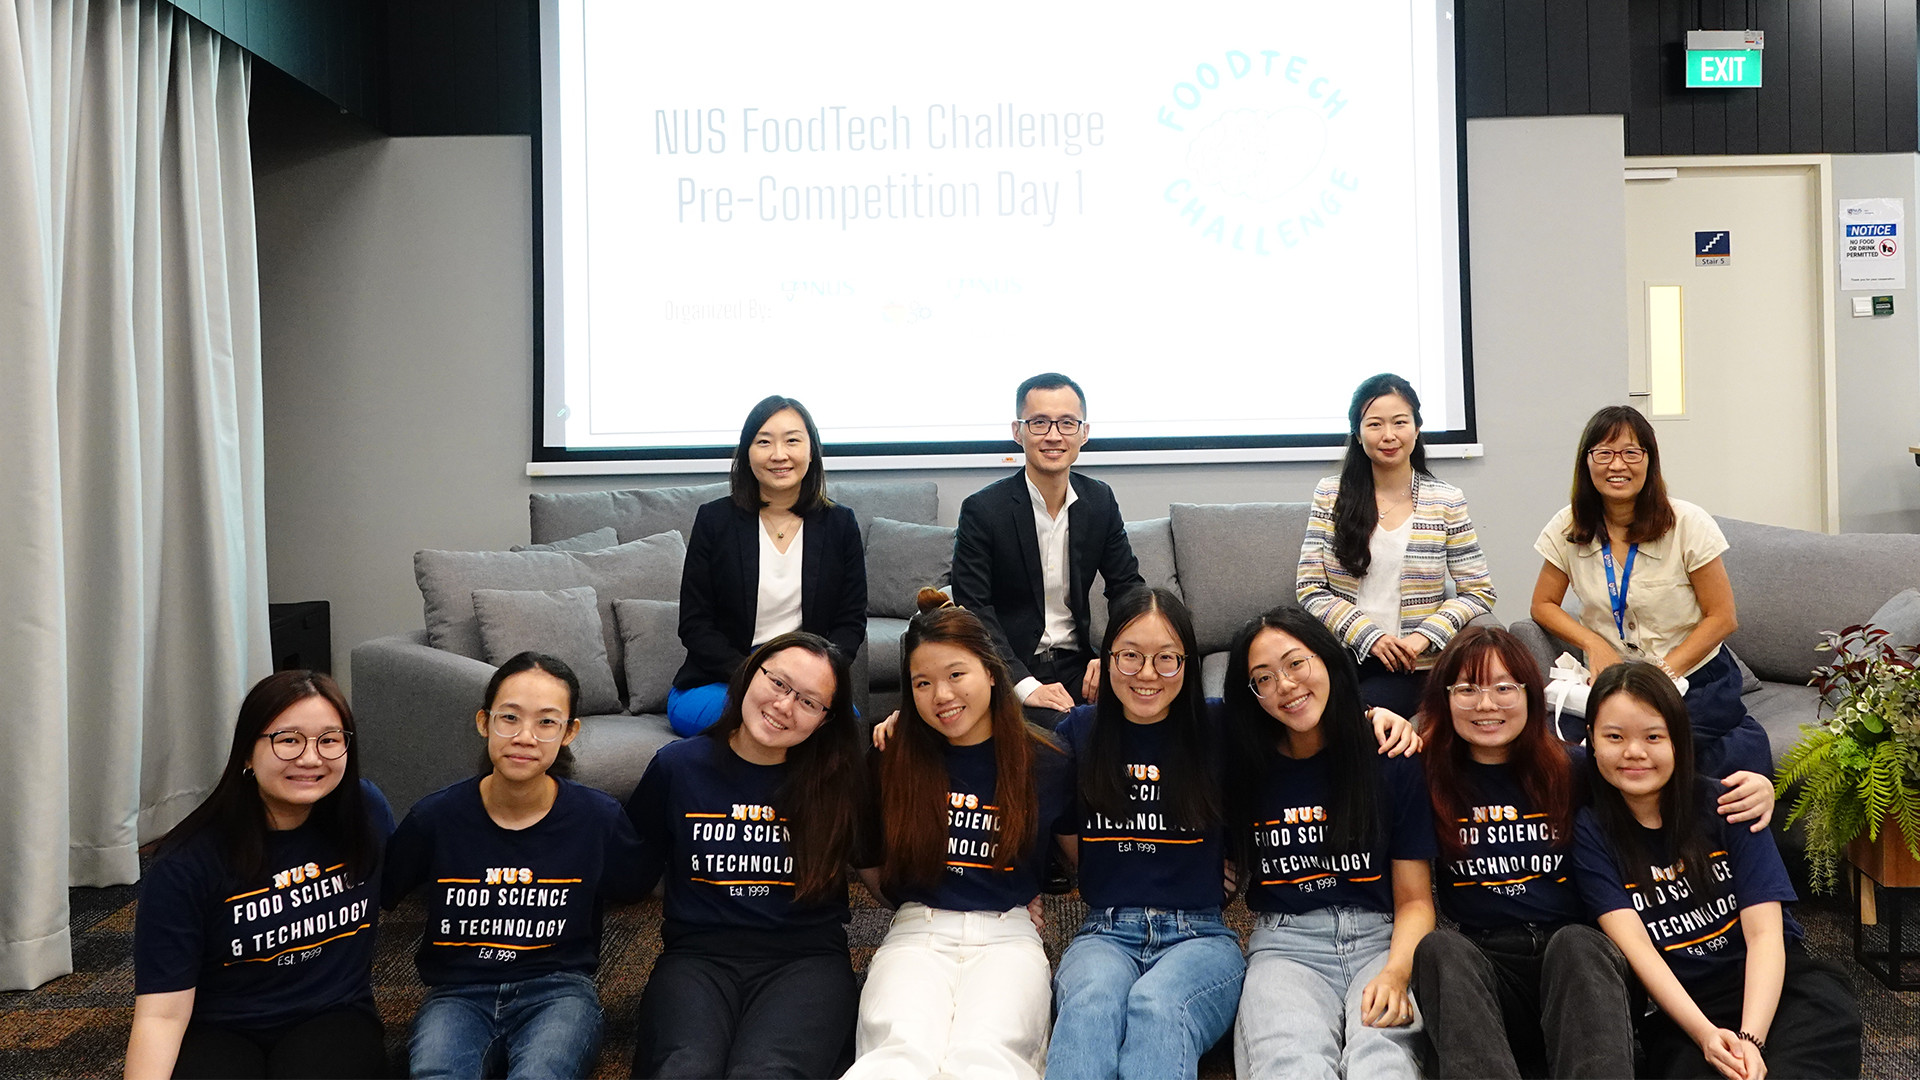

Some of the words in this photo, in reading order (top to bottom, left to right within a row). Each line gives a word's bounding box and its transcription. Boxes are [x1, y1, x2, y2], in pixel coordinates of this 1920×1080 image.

[1701, 56, 1746, 82] EXIT
[1157, 49, 1349, 133] FOODTECH
[654, 106, 727, 156] NUS
[742, 103, 912, 154] FoodTech
[926, 98, 1105, 156] Challenge
[677, 172, 982, 231] Pre-Competition
[997, 170, 1060, 226] Day
[1074, 170, 1087, 216] 1
[1162, 168, 1359, 257] CHALLENGE
[1851, 225, 1891, 236] NOTICE
[946, 792, 980, 810] US
[731, 804, 776, 822] NUS
[947, 809, 1001, 832] SCIENC
[1283, 805, 1327, 824] NUS
[1472, 805, 1519, 823] NUS
[693, 823, 736, 842] FOOD
[743, 824, 791, 843] SCIEN
[1459, 827, 1480, 846] OD
[1487, 822, 1560, 845] SCIENCE
[1136, 842, 1157, 854] 1999
[691, 854, 700, 871] &
[705, 854, 794, 874] TECHNOLO
[1262, 858, 1271, 874] &
[1456, 854, 1564, 877] TECHNOLOGY
[272, 861, 321, 890] NUS
[485, 867, 533, 885] NUS
[1317, 877, 1337, 890] 1999
[445, 887, 490, 907] FOOD
[497, 887, 569, 907] SCIENCE
[748, 885, 770, 897] 1999
[1505, 883, 1527, 896] 1999
[233, 894, 284, 925] FOOD
[1647, 893, 1738, 941] TECHNOLOG
[231, 938, 243, 956] &
[252, 898, 369, 952] TECHNOLOGY
[440, 919, 451, 935] &
[458, 918, 567, 937] TECHNOLOGY
[1706, 936, 1729, 952] 1999
[300, 947, 322, 962] 1999
[495, 948, 517, 962] 1999
